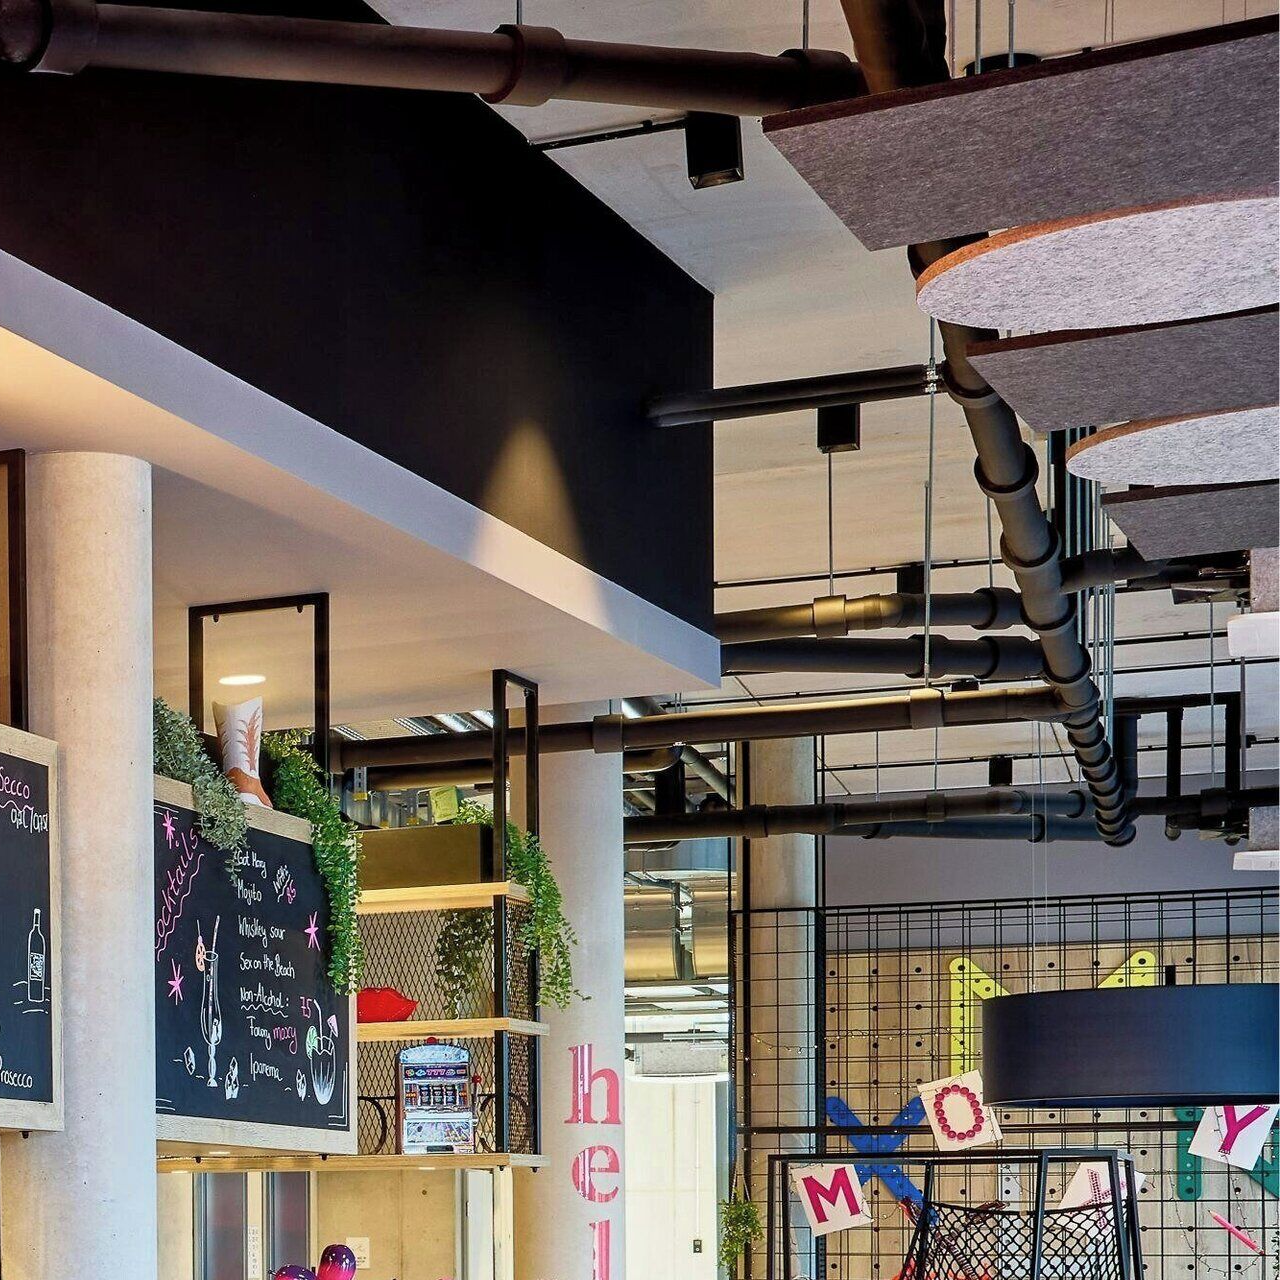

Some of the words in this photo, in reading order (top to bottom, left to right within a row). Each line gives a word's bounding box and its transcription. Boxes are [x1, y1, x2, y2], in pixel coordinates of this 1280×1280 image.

[154, 827, 198, 949] ocktails
[237, 878, 262, 905] Mojito
[240, 952, 253, 971] Sex
[253, 960, 262, 970] on
[263, 954, 274, 971] the
[275, 954, 295, 979] Beach
[250, 1053, 283, 1081] Ipanema
